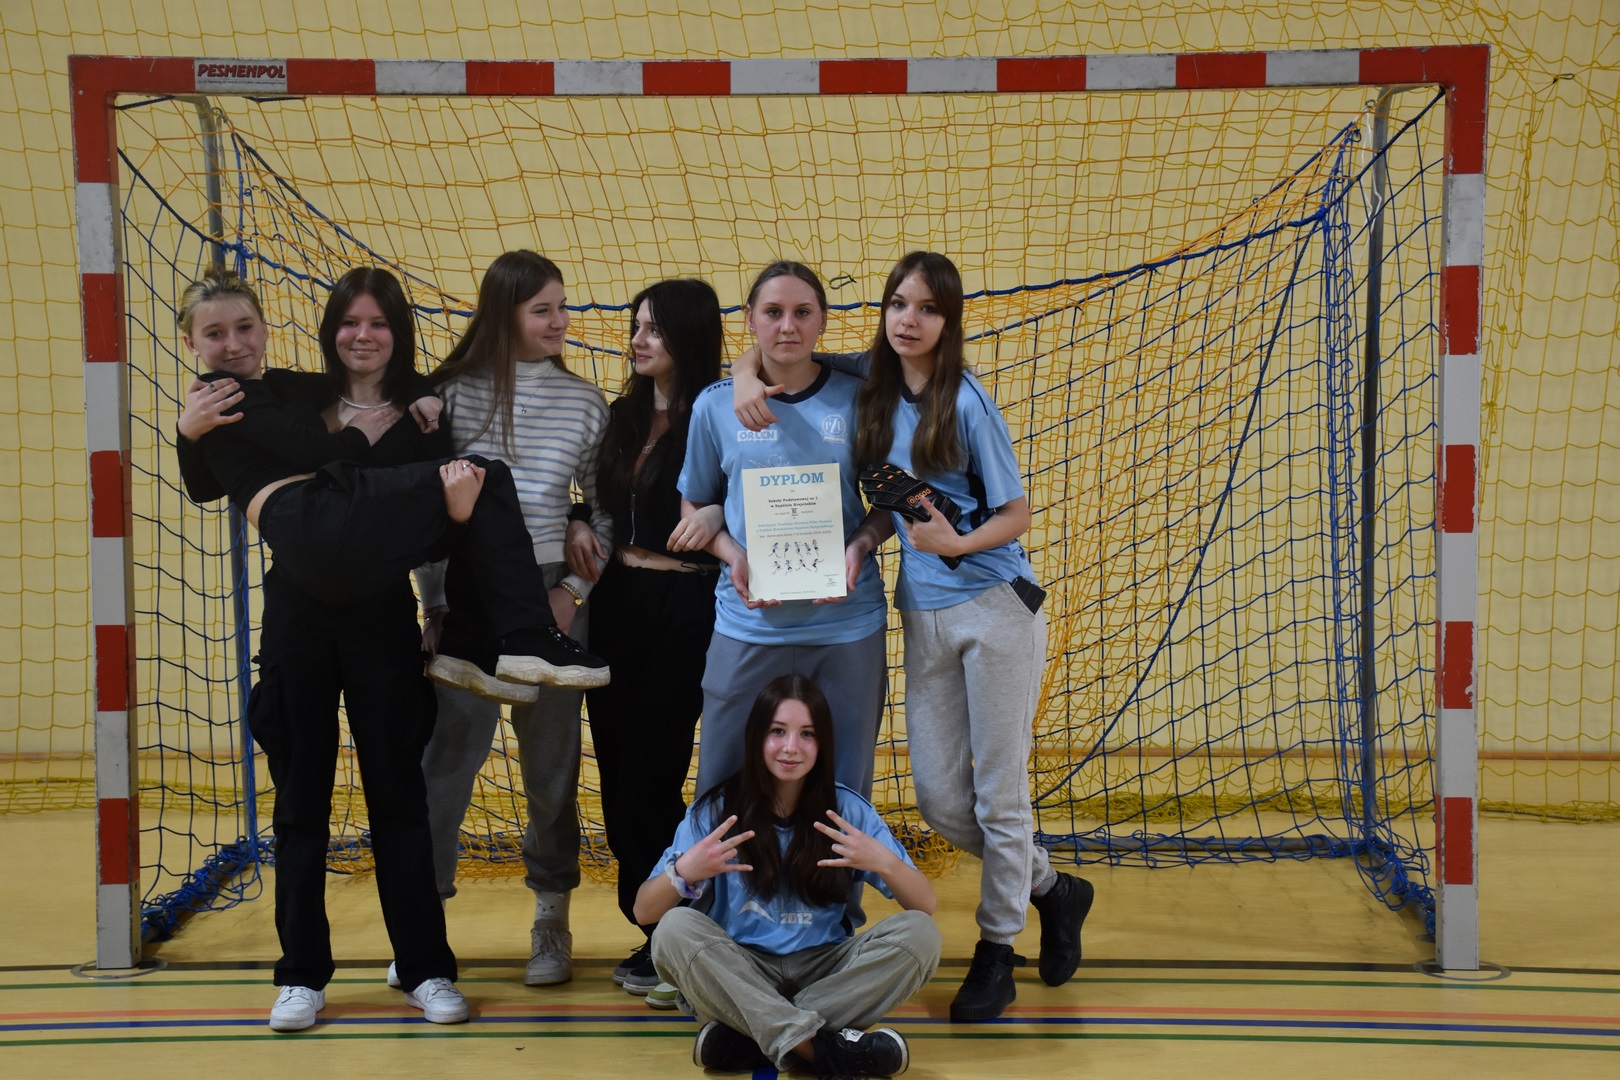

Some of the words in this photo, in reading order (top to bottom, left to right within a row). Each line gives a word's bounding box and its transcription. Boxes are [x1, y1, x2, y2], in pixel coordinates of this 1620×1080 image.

[197, 63, 286, 79] PESMENPOL
[740, 430, 775, 440] ORLEN
[759, 471, 825, 487] DYPLOM
[780, 912, 813, 925] 2012
